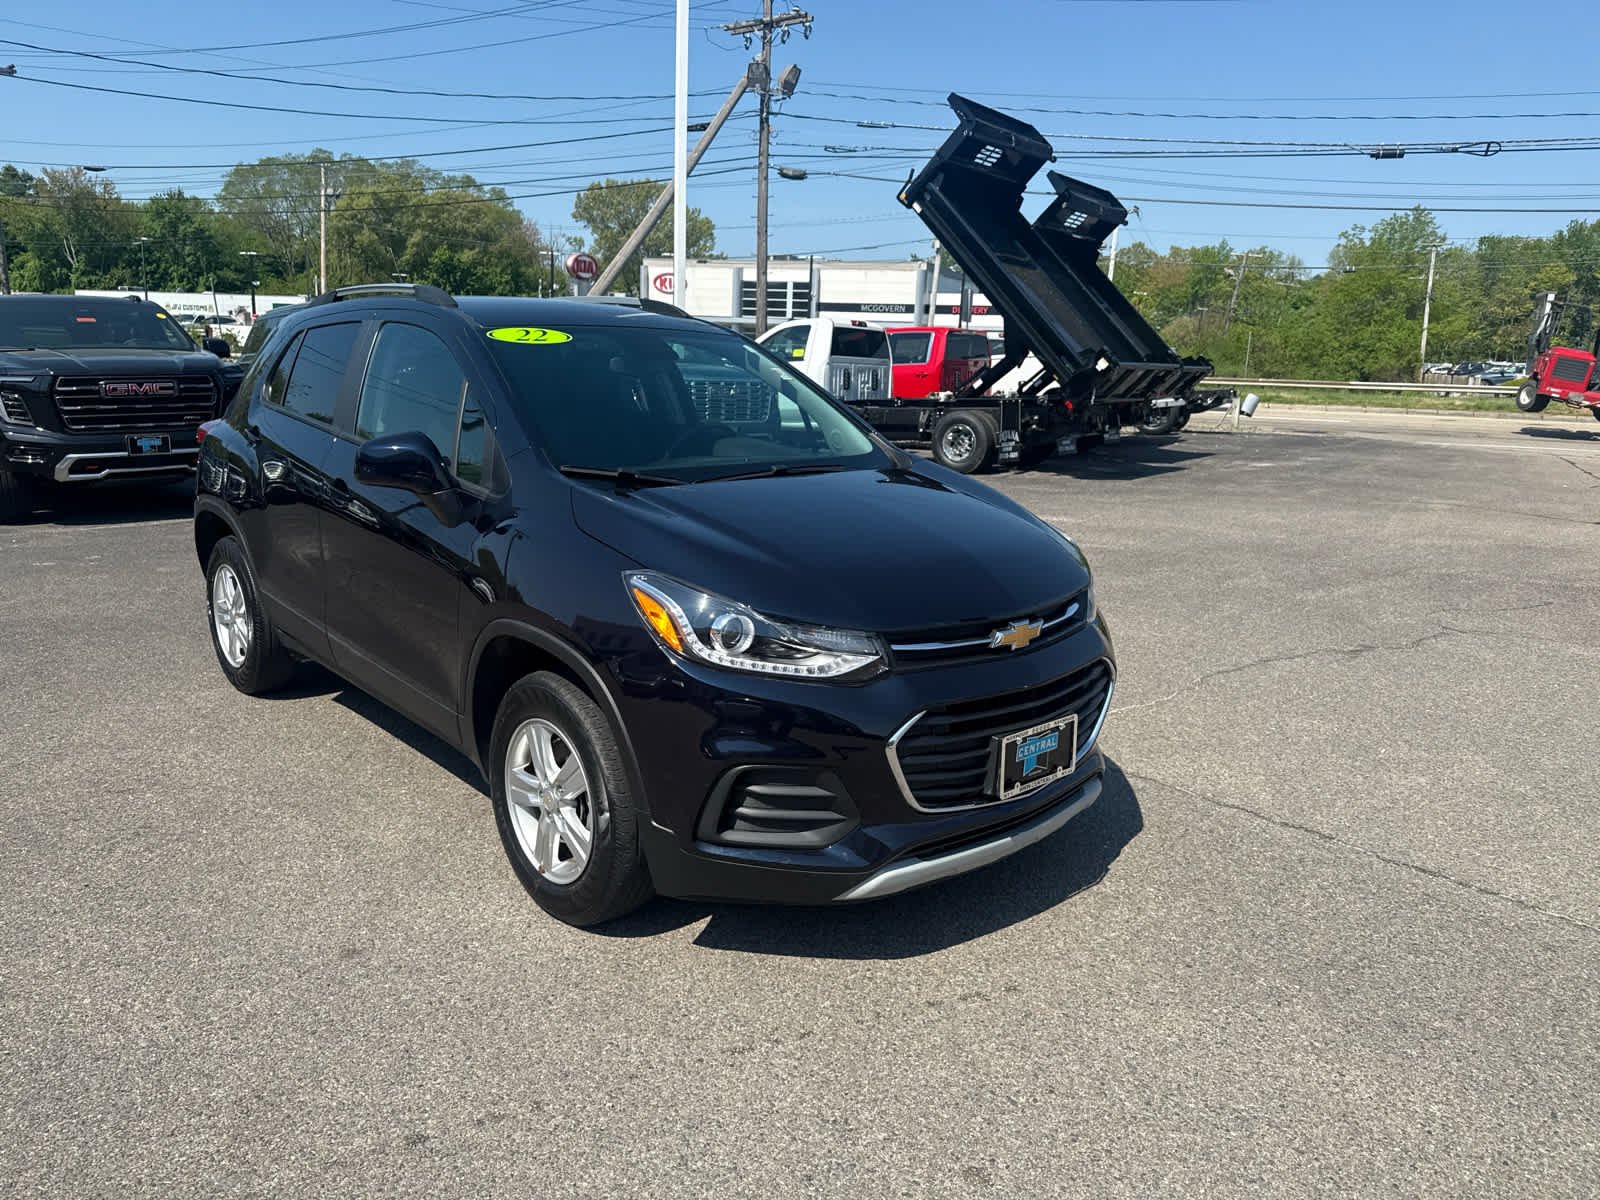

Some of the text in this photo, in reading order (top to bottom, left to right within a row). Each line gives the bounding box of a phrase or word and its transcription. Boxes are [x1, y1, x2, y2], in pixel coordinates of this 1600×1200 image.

[182, 304, 208, 312] CUSTOMS
[860, 304, 906, 313] MCGOVERN
[515, 329, 548, 342] 22
[106, 383, 175, 396] GMC
[1018, 735, 1057, 758] CENTRAL
